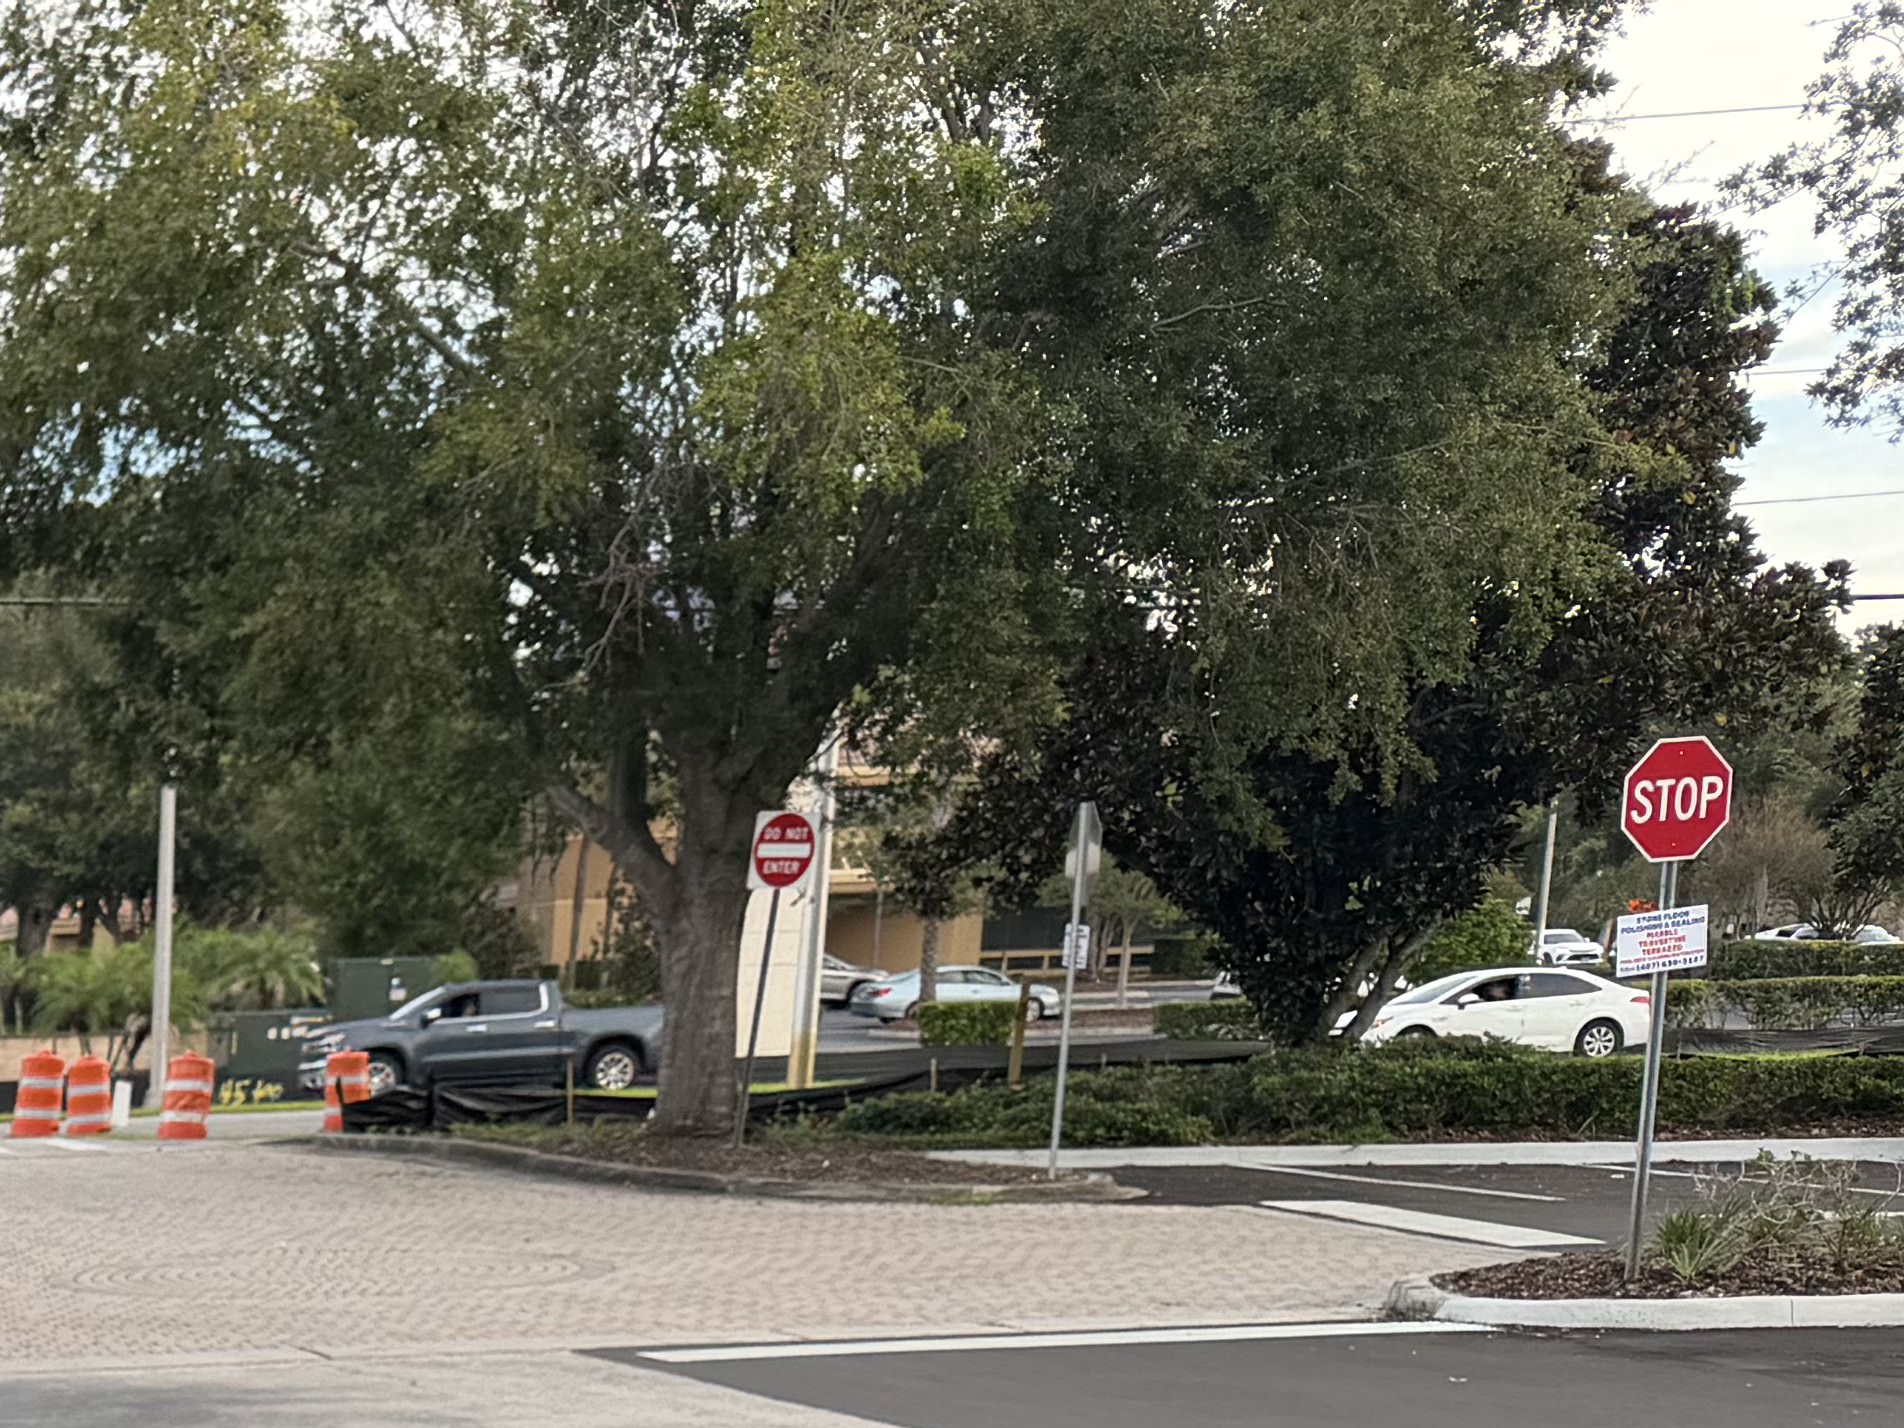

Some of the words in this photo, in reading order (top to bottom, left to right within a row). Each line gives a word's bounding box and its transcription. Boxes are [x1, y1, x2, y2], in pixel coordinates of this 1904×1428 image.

[1630, 775, 1724, 824] STOP
[764, 827, 782, 840] DO
[785, 827, 809, 840] NOT
[763, 860, 800, 874] ENTER
